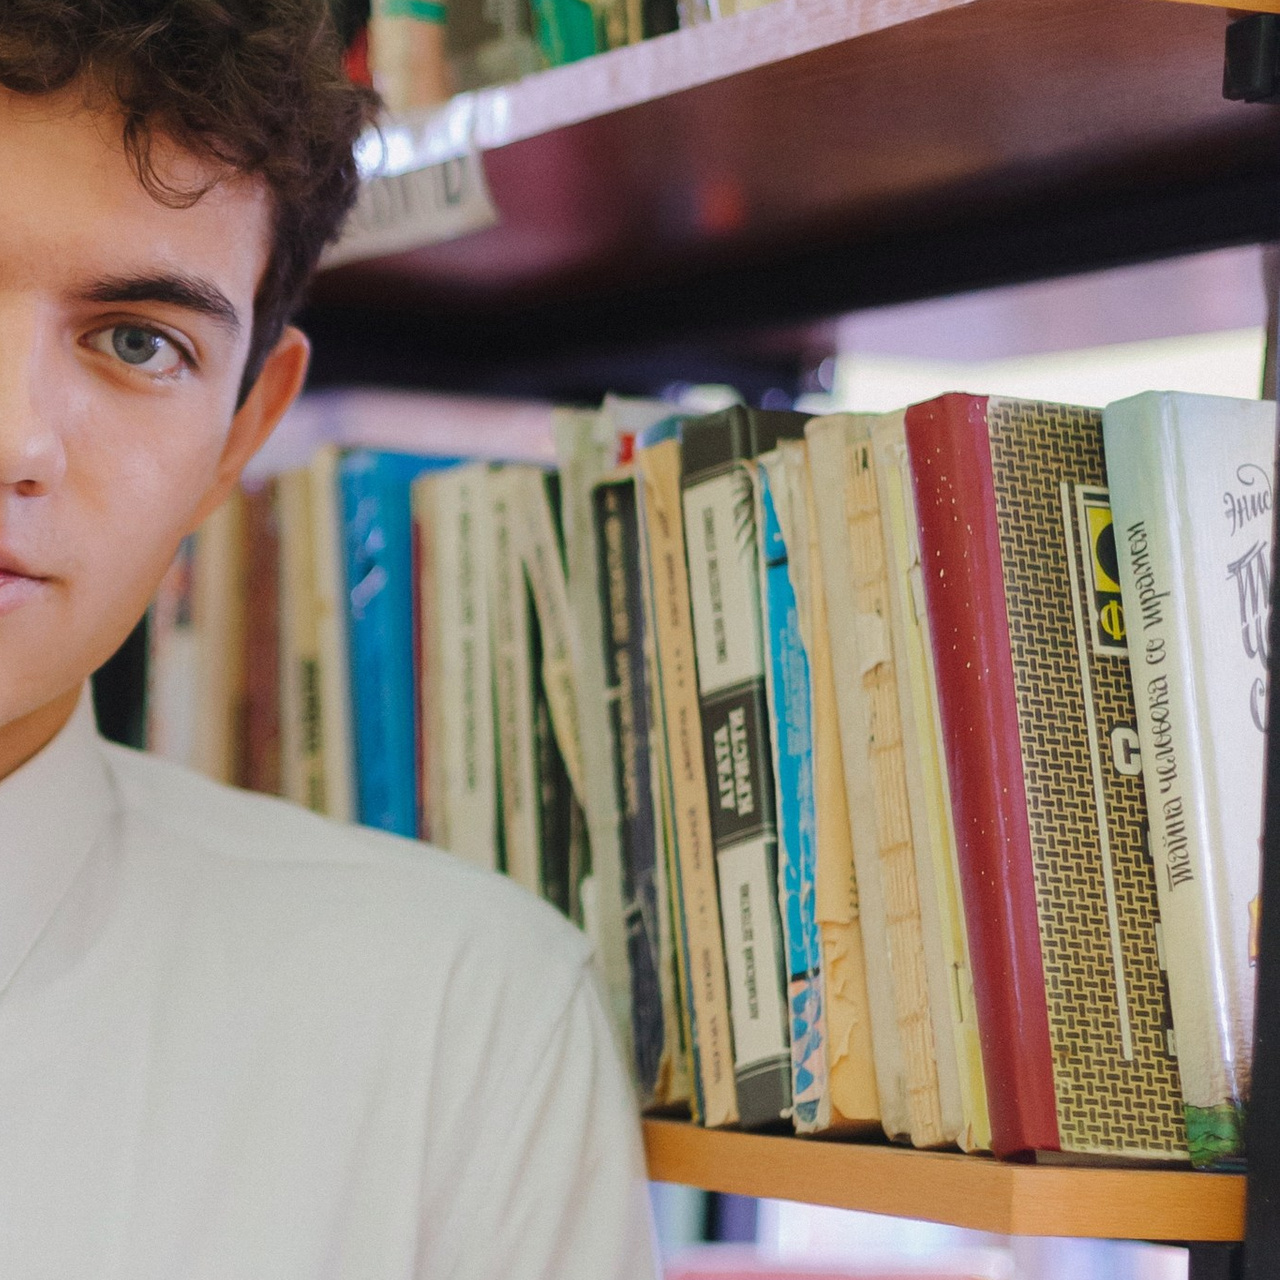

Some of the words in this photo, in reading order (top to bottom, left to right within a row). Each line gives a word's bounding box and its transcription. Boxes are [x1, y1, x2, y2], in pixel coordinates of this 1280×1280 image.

[1125, 520, 1170, 630] шрамом
[1144, 637, 1168, 666] со
[713, 725, 735, 809] АГАТА
[728, 706, 755, 816] КРИСТИ
[1148, 675, 1182, 793] человека
[1166, 796, 1195, 892] Тайна
